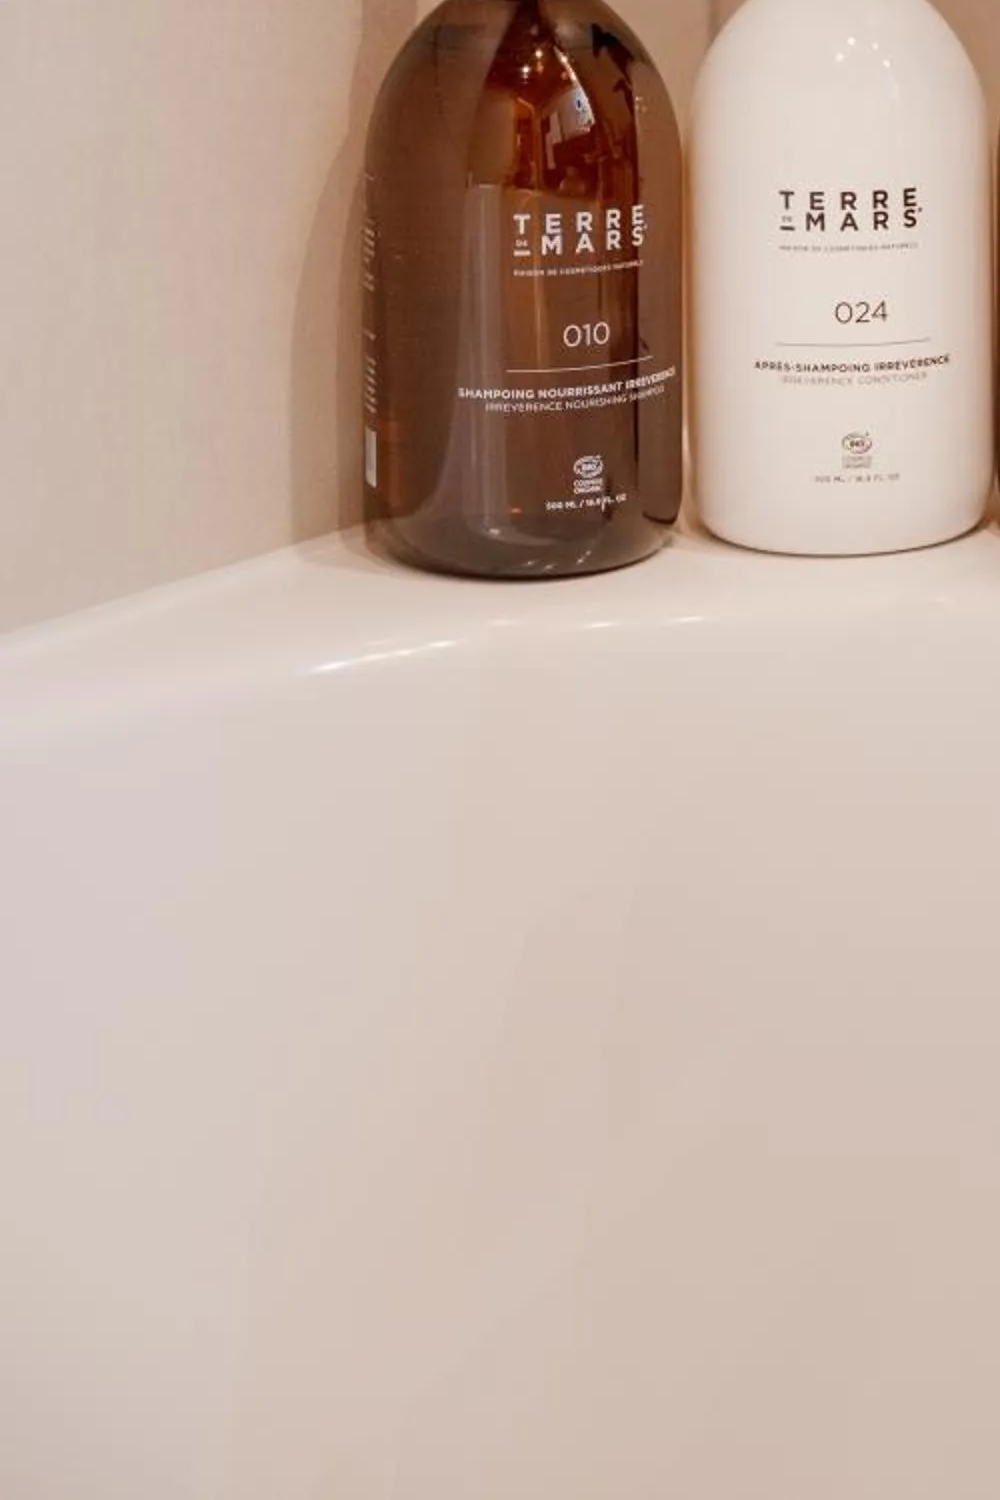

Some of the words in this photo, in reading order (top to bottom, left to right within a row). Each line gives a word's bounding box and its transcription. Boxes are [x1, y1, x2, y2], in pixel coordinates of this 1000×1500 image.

[778, 187, 917, 211] TERRE
[513, 205, 644, 235] TERRE
[805, 209, 917, 232] MARS
[541, 231, 644, 256] MARS
[834, 300, 888, 323] 024
[563, 321, 610, 347] 010
[457, 387, 534, 399] SHAMPOING
[537, 381, 623, 399] NOURRISSANT
